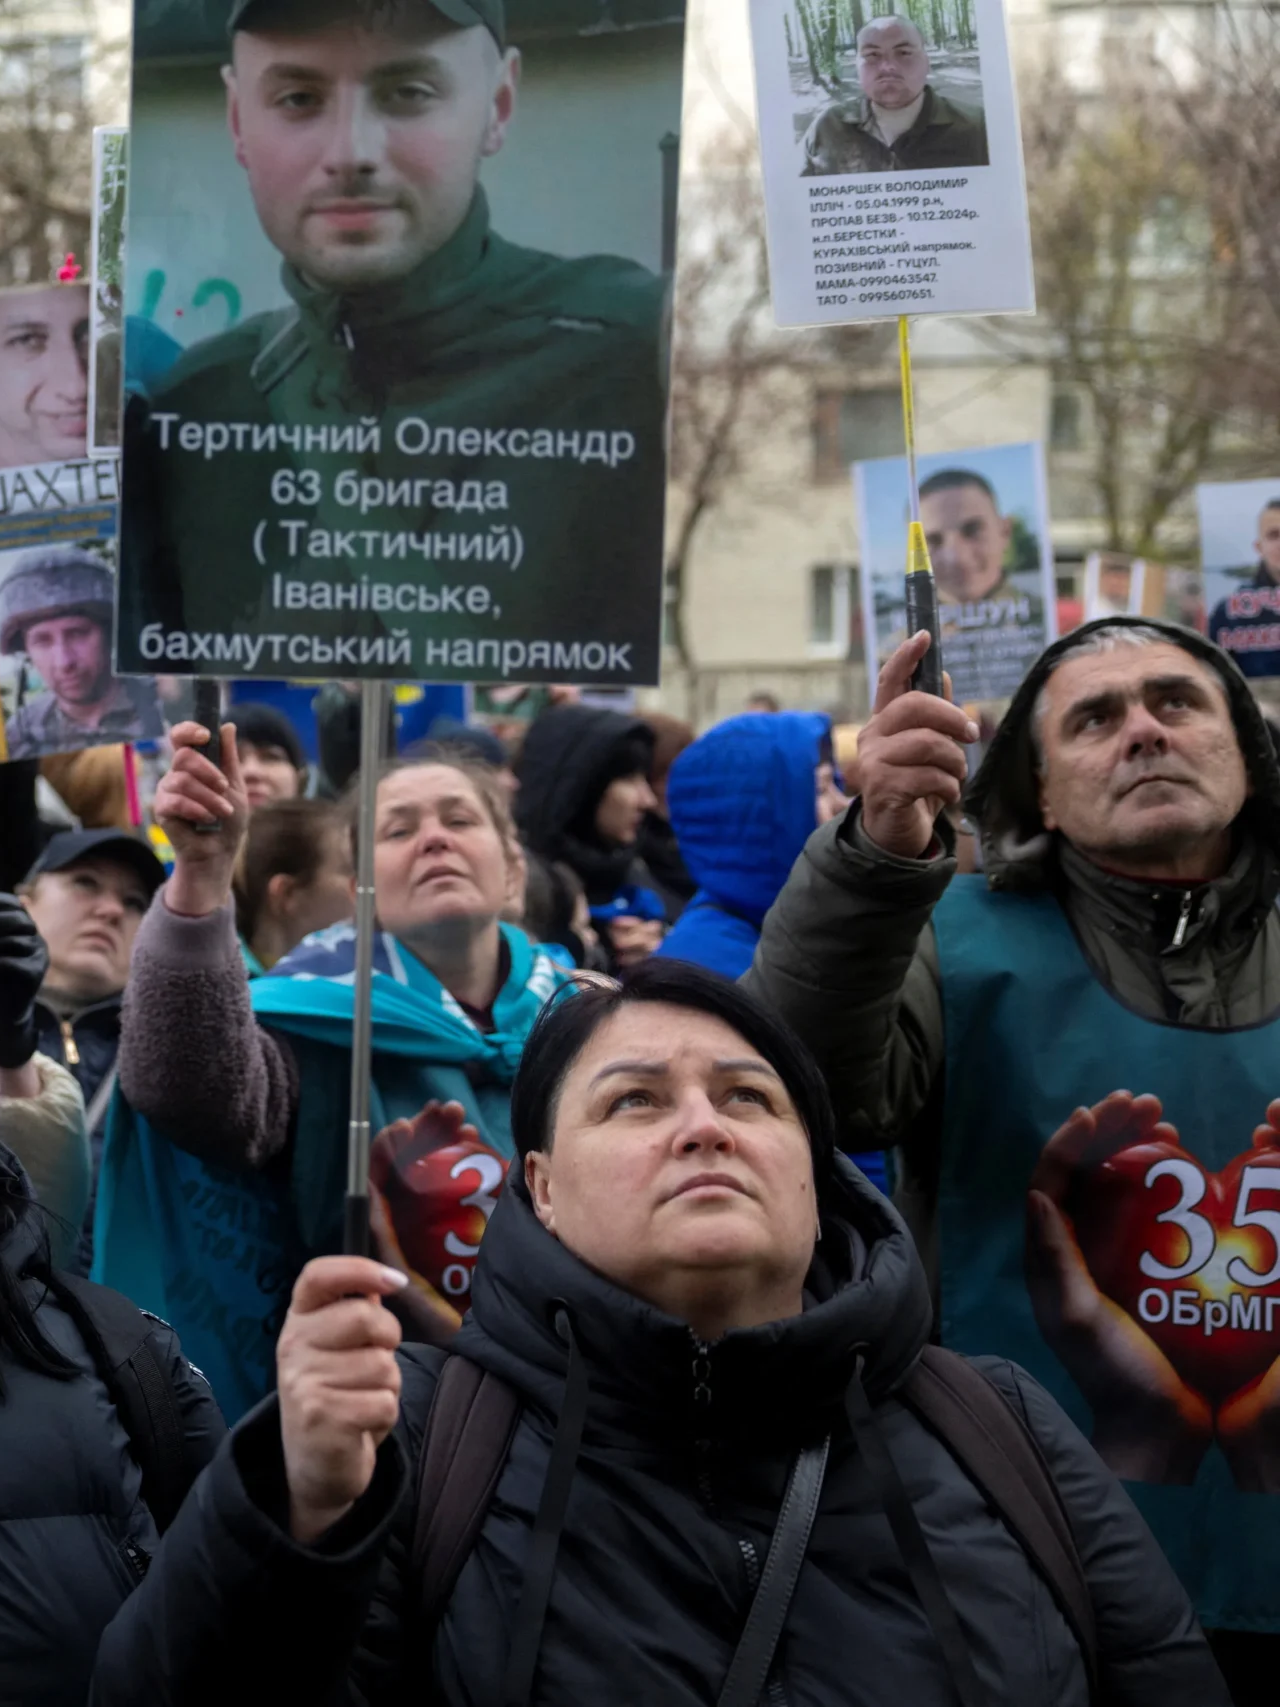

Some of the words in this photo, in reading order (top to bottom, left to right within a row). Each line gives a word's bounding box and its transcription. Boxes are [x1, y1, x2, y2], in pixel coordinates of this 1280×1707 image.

[809, 183, 883, 197] МОНАРШЕК
[885, 178, 968, 192] ВОЛОДИМИР
[810, 202, 844, 213] ІЛЛІЧ
[855, 196, 919, 210] 05.04.1999
[812, 215, 863, 228] ПРОПАВ
[814, 242, 910, 259] КУРАХІВСЬКИЙ
[914, 241, 976, 252] напрямок.
[815, 258, 886, 274] ПОЗИВНИЙ
[817, 294, 848, 306] ТАТО
[151, 412, 381, 459] Тертичний
[395, 417, 635, 467] Олександр
[270, 469, 321, 505] 63
[334, 470, 508, 514] бригада
[272, 573, 502, 620] Іванівське,
[139, 624, 411, 671] бахмутський
[426, 637, 632, 676] напрямок
[1139, 1158, 1280, 1288] 35
